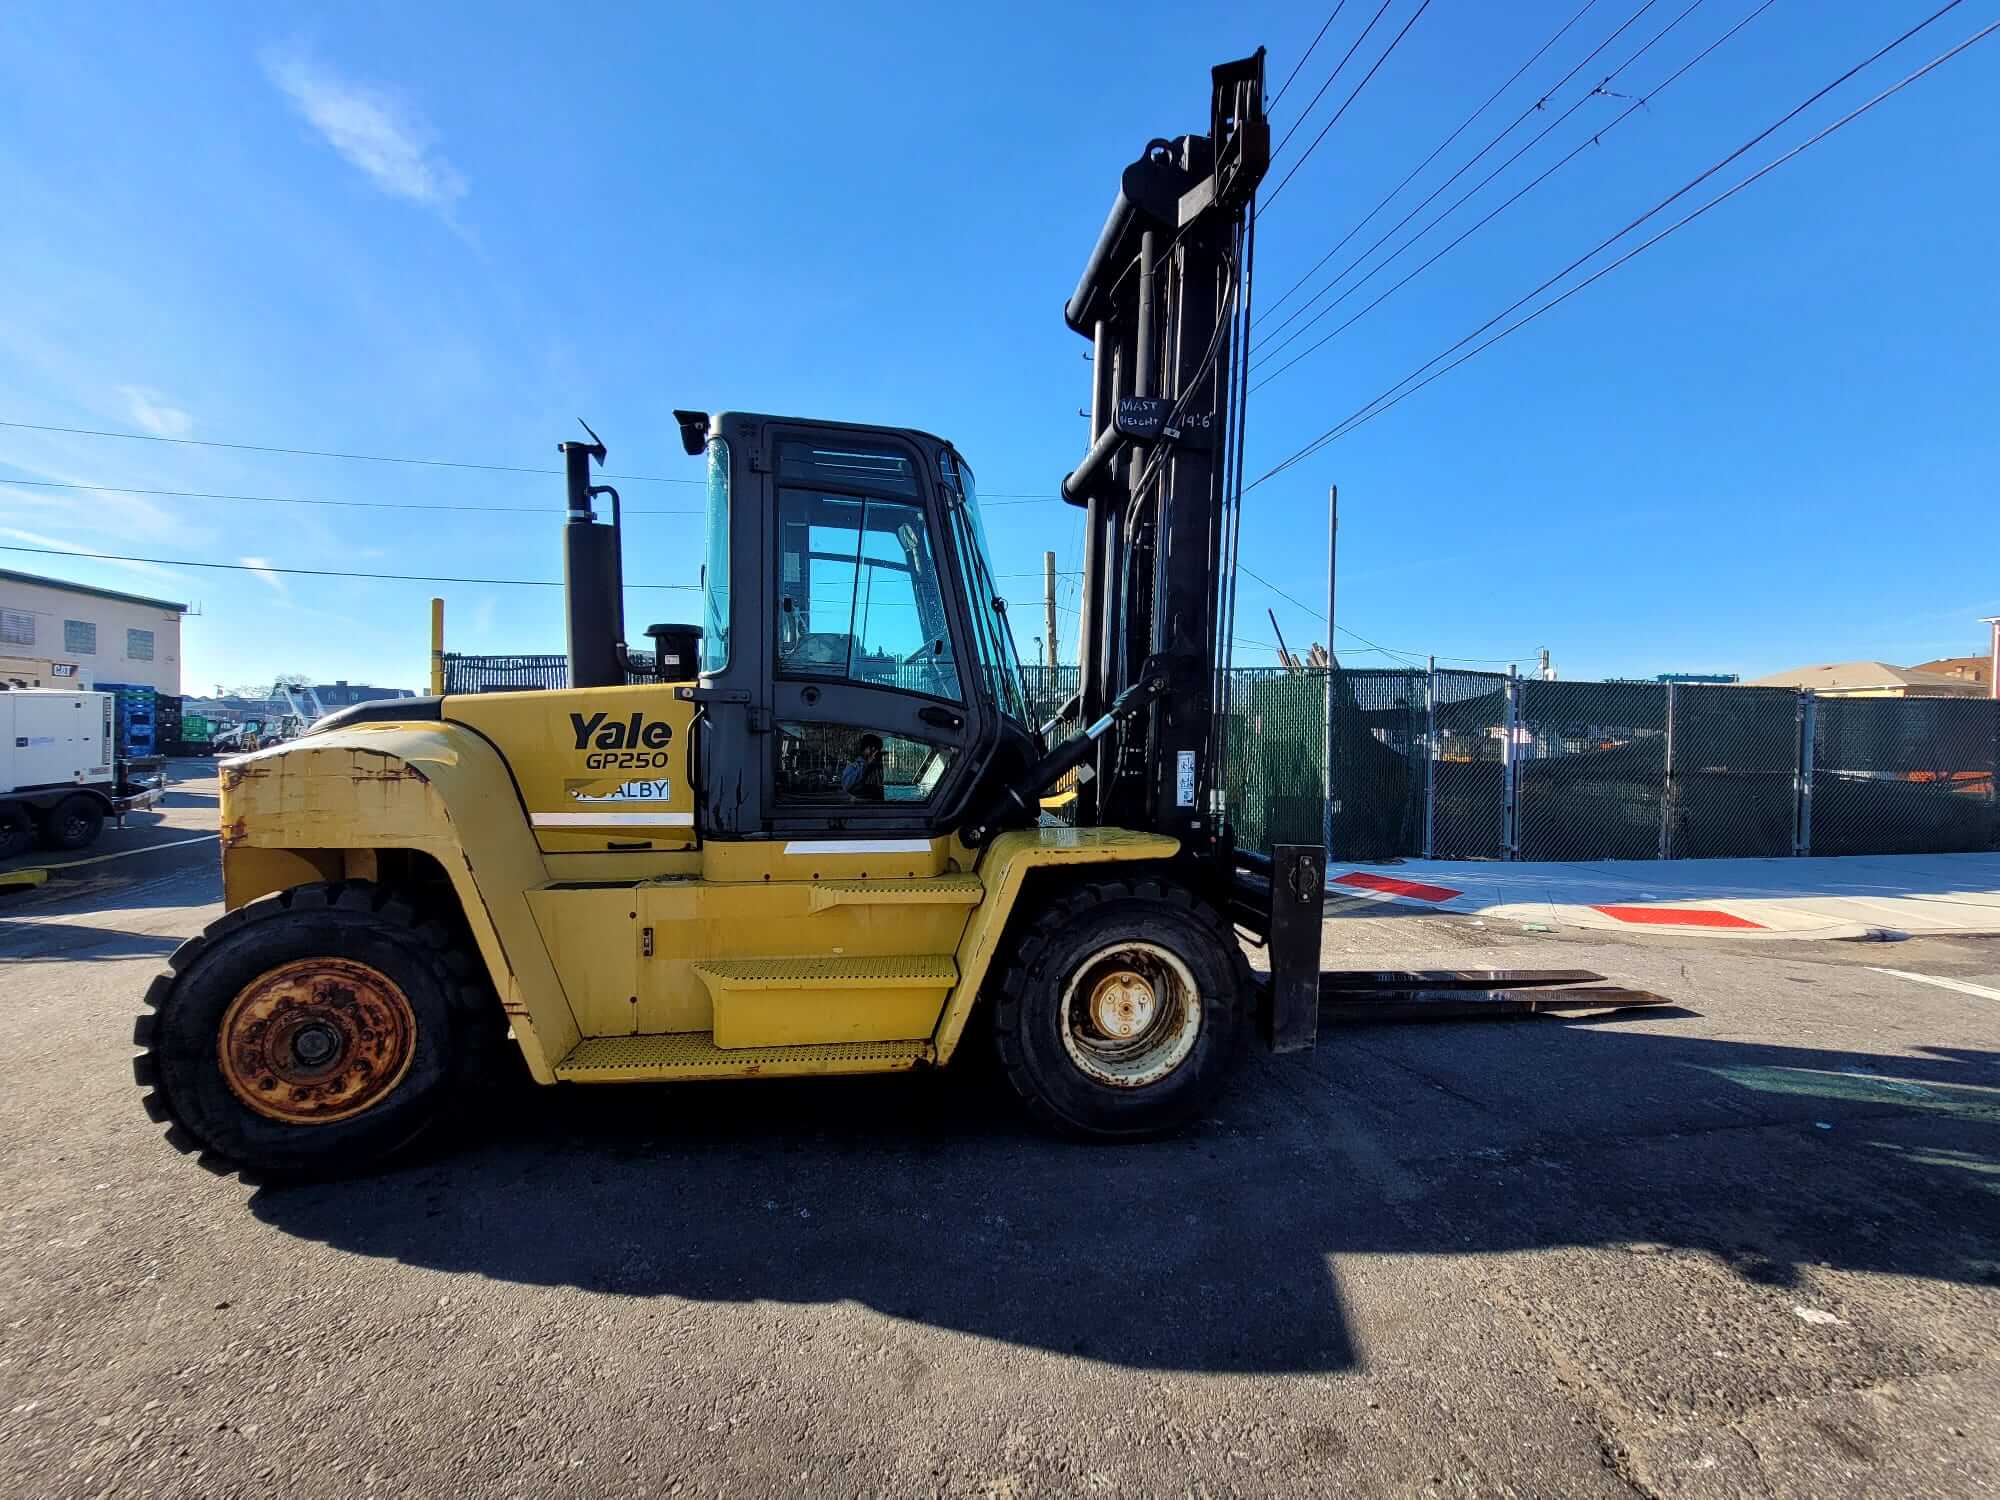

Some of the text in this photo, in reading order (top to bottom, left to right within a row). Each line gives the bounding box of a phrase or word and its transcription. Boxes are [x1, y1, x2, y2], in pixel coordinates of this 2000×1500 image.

[1120, 400, 1158, 413] MAST
[1119, 415, 1159, 427] HEIGHT
[569, 712, 673, 750] Yale
[586, 751, 669, 770] GP250
